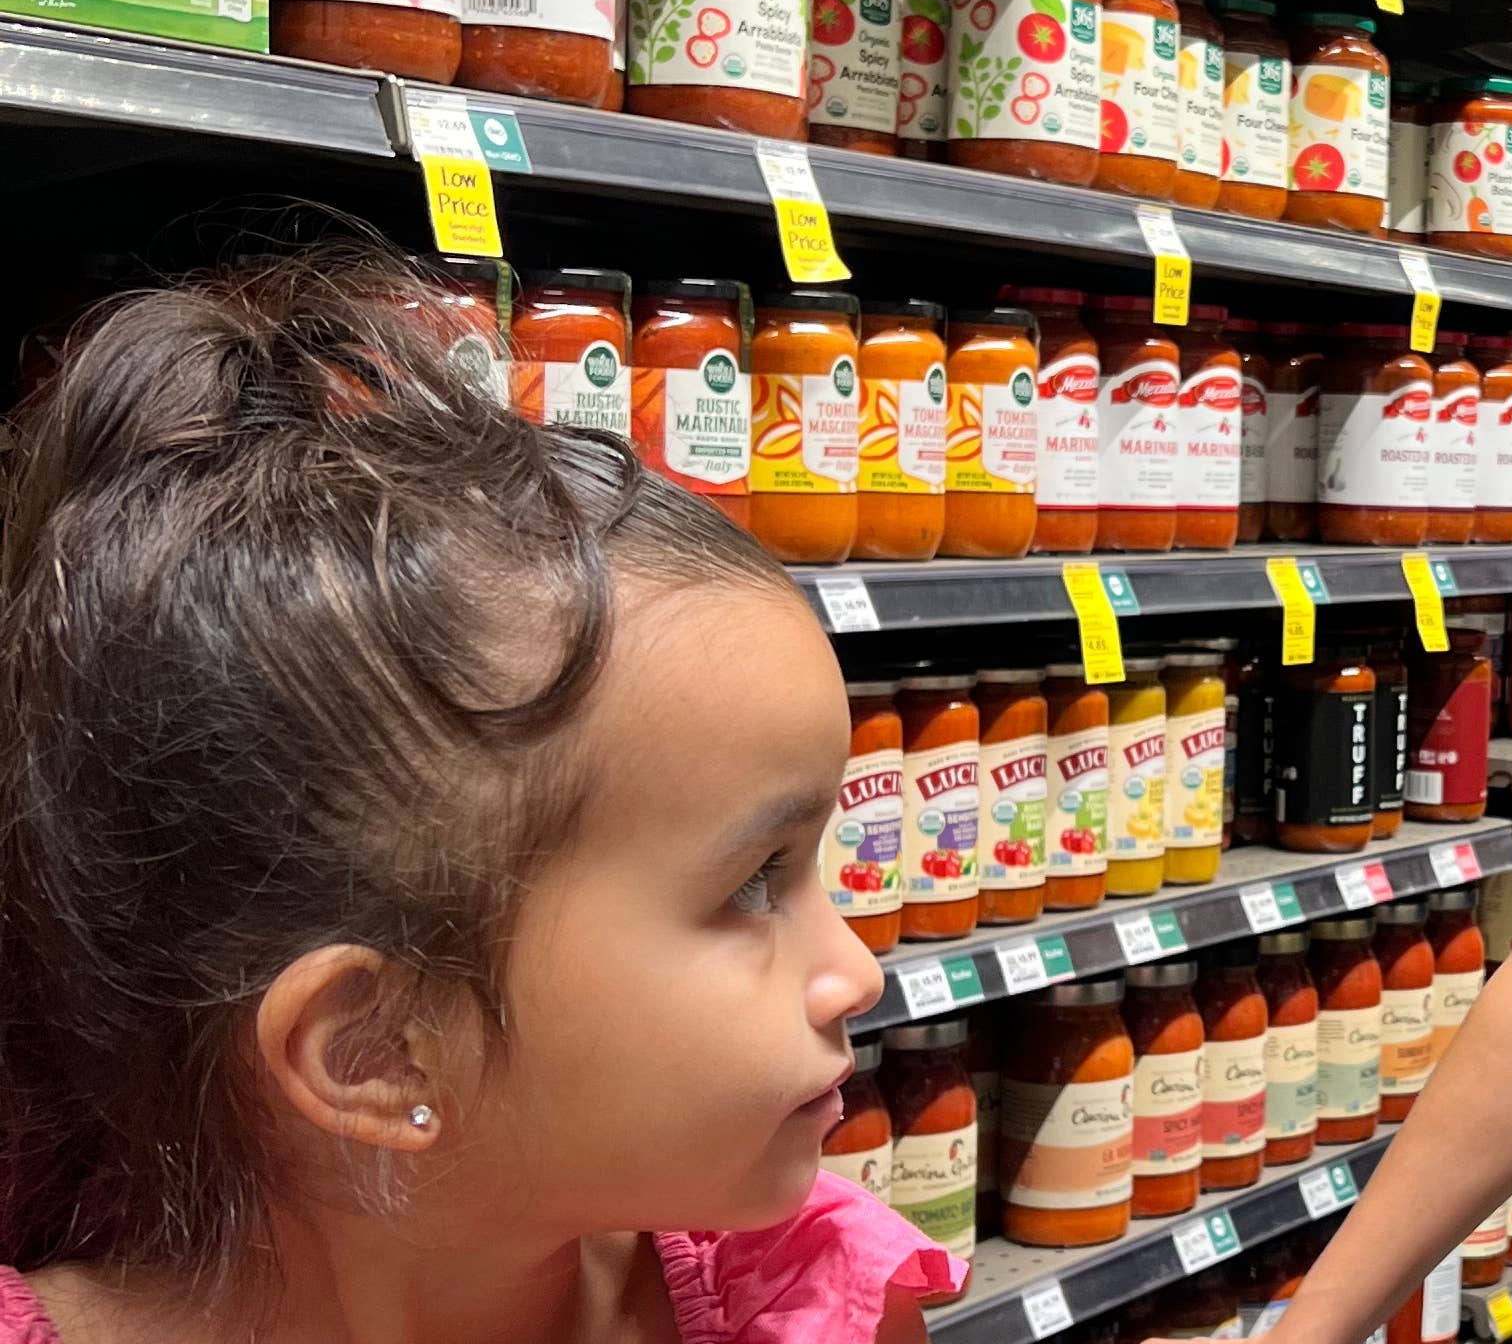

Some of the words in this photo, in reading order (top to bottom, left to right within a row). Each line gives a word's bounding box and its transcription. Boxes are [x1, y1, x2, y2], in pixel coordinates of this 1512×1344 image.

[757, 1, 792, 24] Spicy
[859, 48, 890, 70] Spicy
[441, 166, 478, 190] Low
[438, 191, 490, 219] Price
[789, 208, 819, 228] Low
[787, 230, 830, 254] Price
[1161, 262, 1184, 278] Low
[1159, 281, 1186, 300] Price
[577, 392, 622, 410] RUSTIC
[696, 398, 741, 415] RUSTIC
[816, 402, 858, 419] TOMAT
[995, 410, 1038, 425] TOMAT
[1352, 703, 1366, 805] TRUFF
